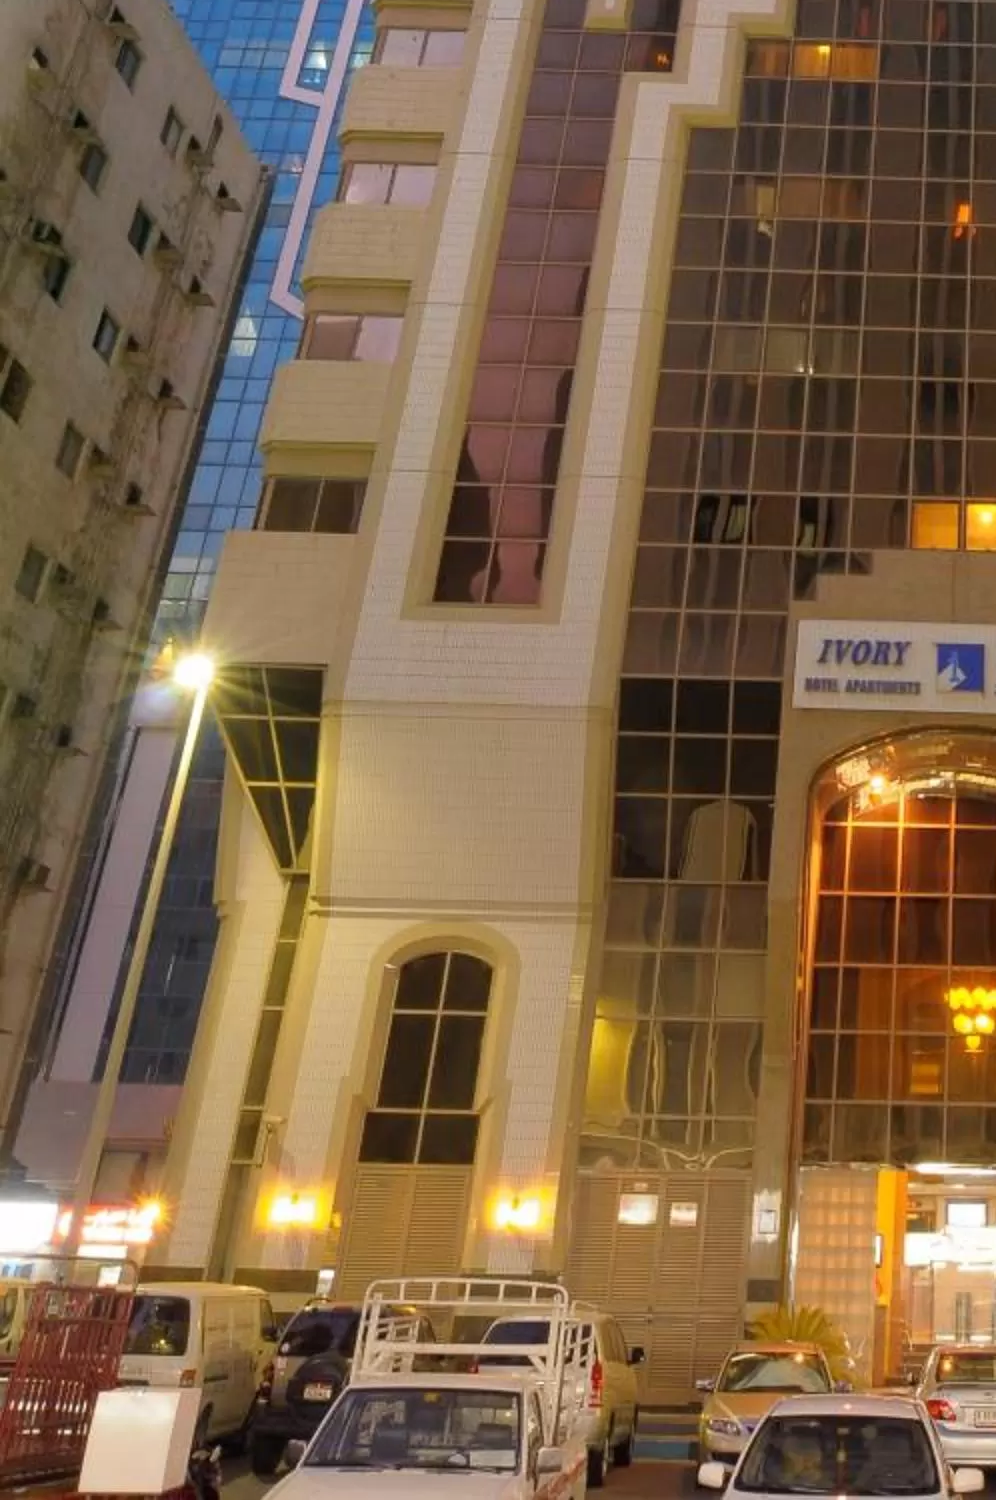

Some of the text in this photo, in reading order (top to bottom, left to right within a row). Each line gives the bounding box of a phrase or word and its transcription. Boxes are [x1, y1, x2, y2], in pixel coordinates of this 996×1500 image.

[817, 639, 912, 666] IVORY
[804, 677, 921, 696] HOTEL APARTMENTS
